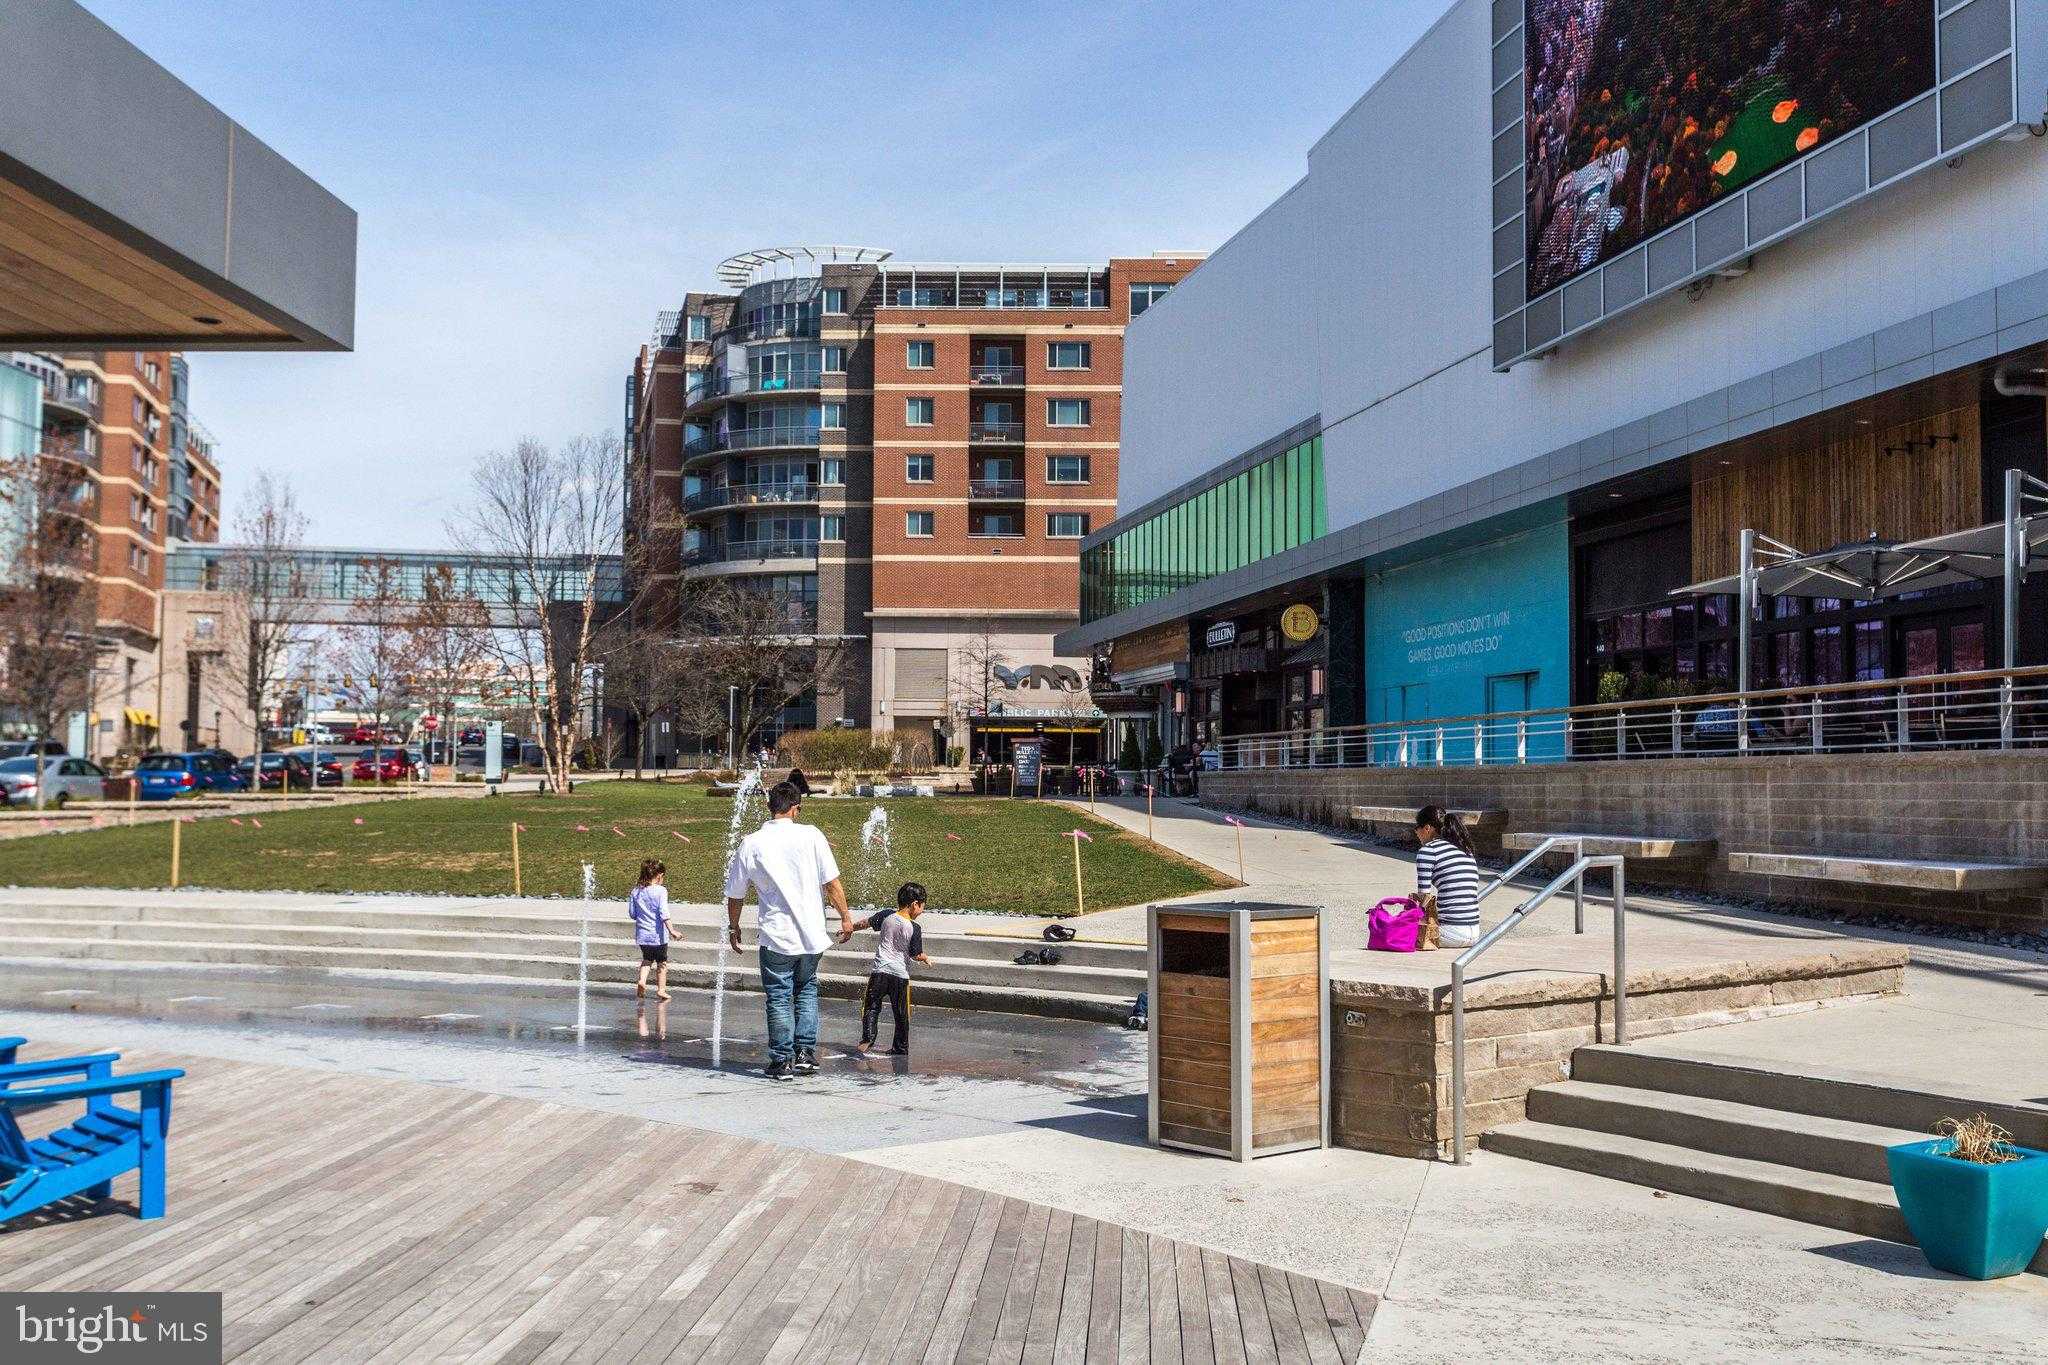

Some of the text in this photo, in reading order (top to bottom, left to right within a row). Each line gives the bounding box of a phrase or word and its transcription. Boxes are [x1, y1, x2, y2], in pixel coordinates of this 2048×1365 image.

[1427, 620, 1465, 641] POSITIONS
[1466, 614, 1492, 633] DON'T
[1493, 611, 1511, 628] WIN
[1434, 643, 1456, 659] GOOD
[1457, 638, 1485, 655] MOVES
